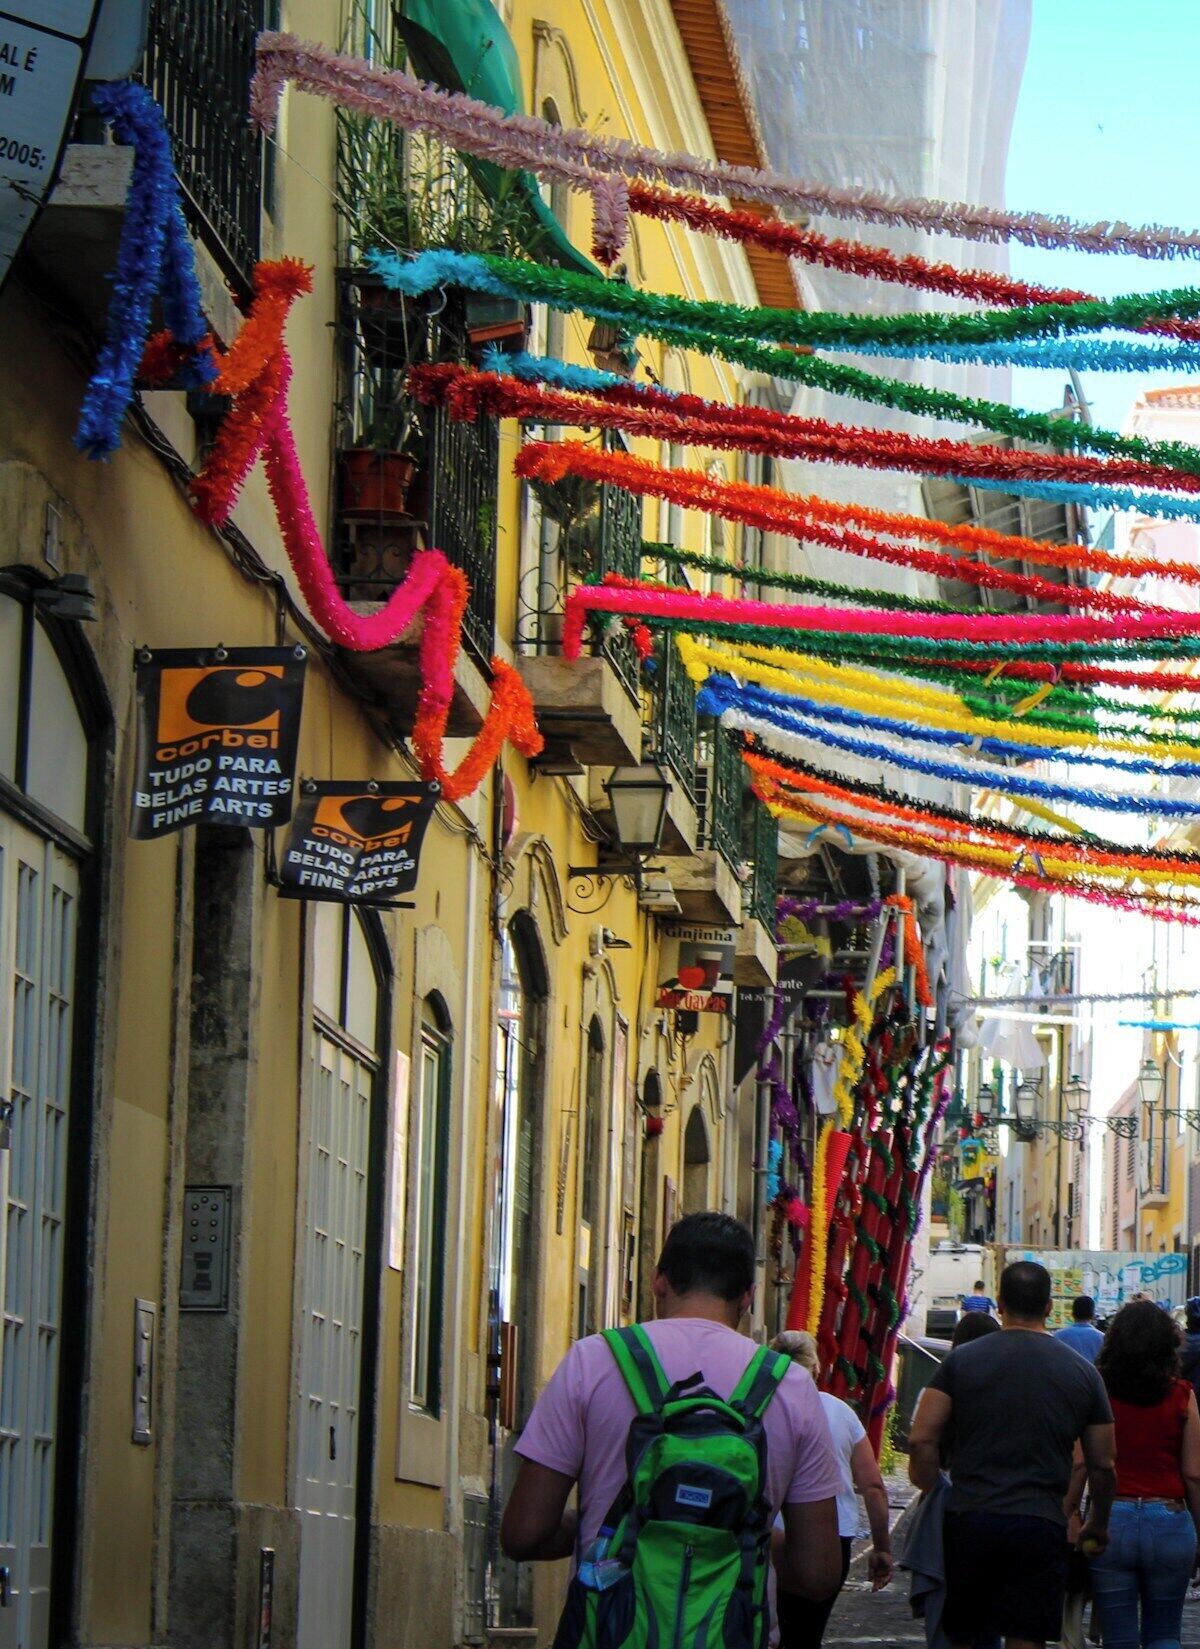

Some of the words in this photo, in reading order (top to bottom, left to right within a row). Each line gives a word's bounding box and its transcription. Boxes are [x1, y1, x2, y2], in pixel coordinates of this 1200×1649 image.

[24, 47, 37, 72] É
[0, 137, 46, 170] 2005:
[155, 729, 279, 762] corbel
[149, 758, 212, 786] TUDO
[218, 756, 282, 774] PARA
[135, 778, 208, 807] BELAS
[214, 776, 292, 796] ARTES
[153, 799, 203, 828] FINE
[209, 797, 273, 818] ARTS
[303, 839, 355, 865] TUDO
[359, 849, 408, 868] PARA
[311, 826, 410, 852] corbel
[288, 850, 350, 878] BELAS
[354, 859, 415, 881] ARTES
[300, 870, 345, 890] FINE
[348, 876, 398, 895] ARTS
[665, 927, 733, 943] Ginjinha
